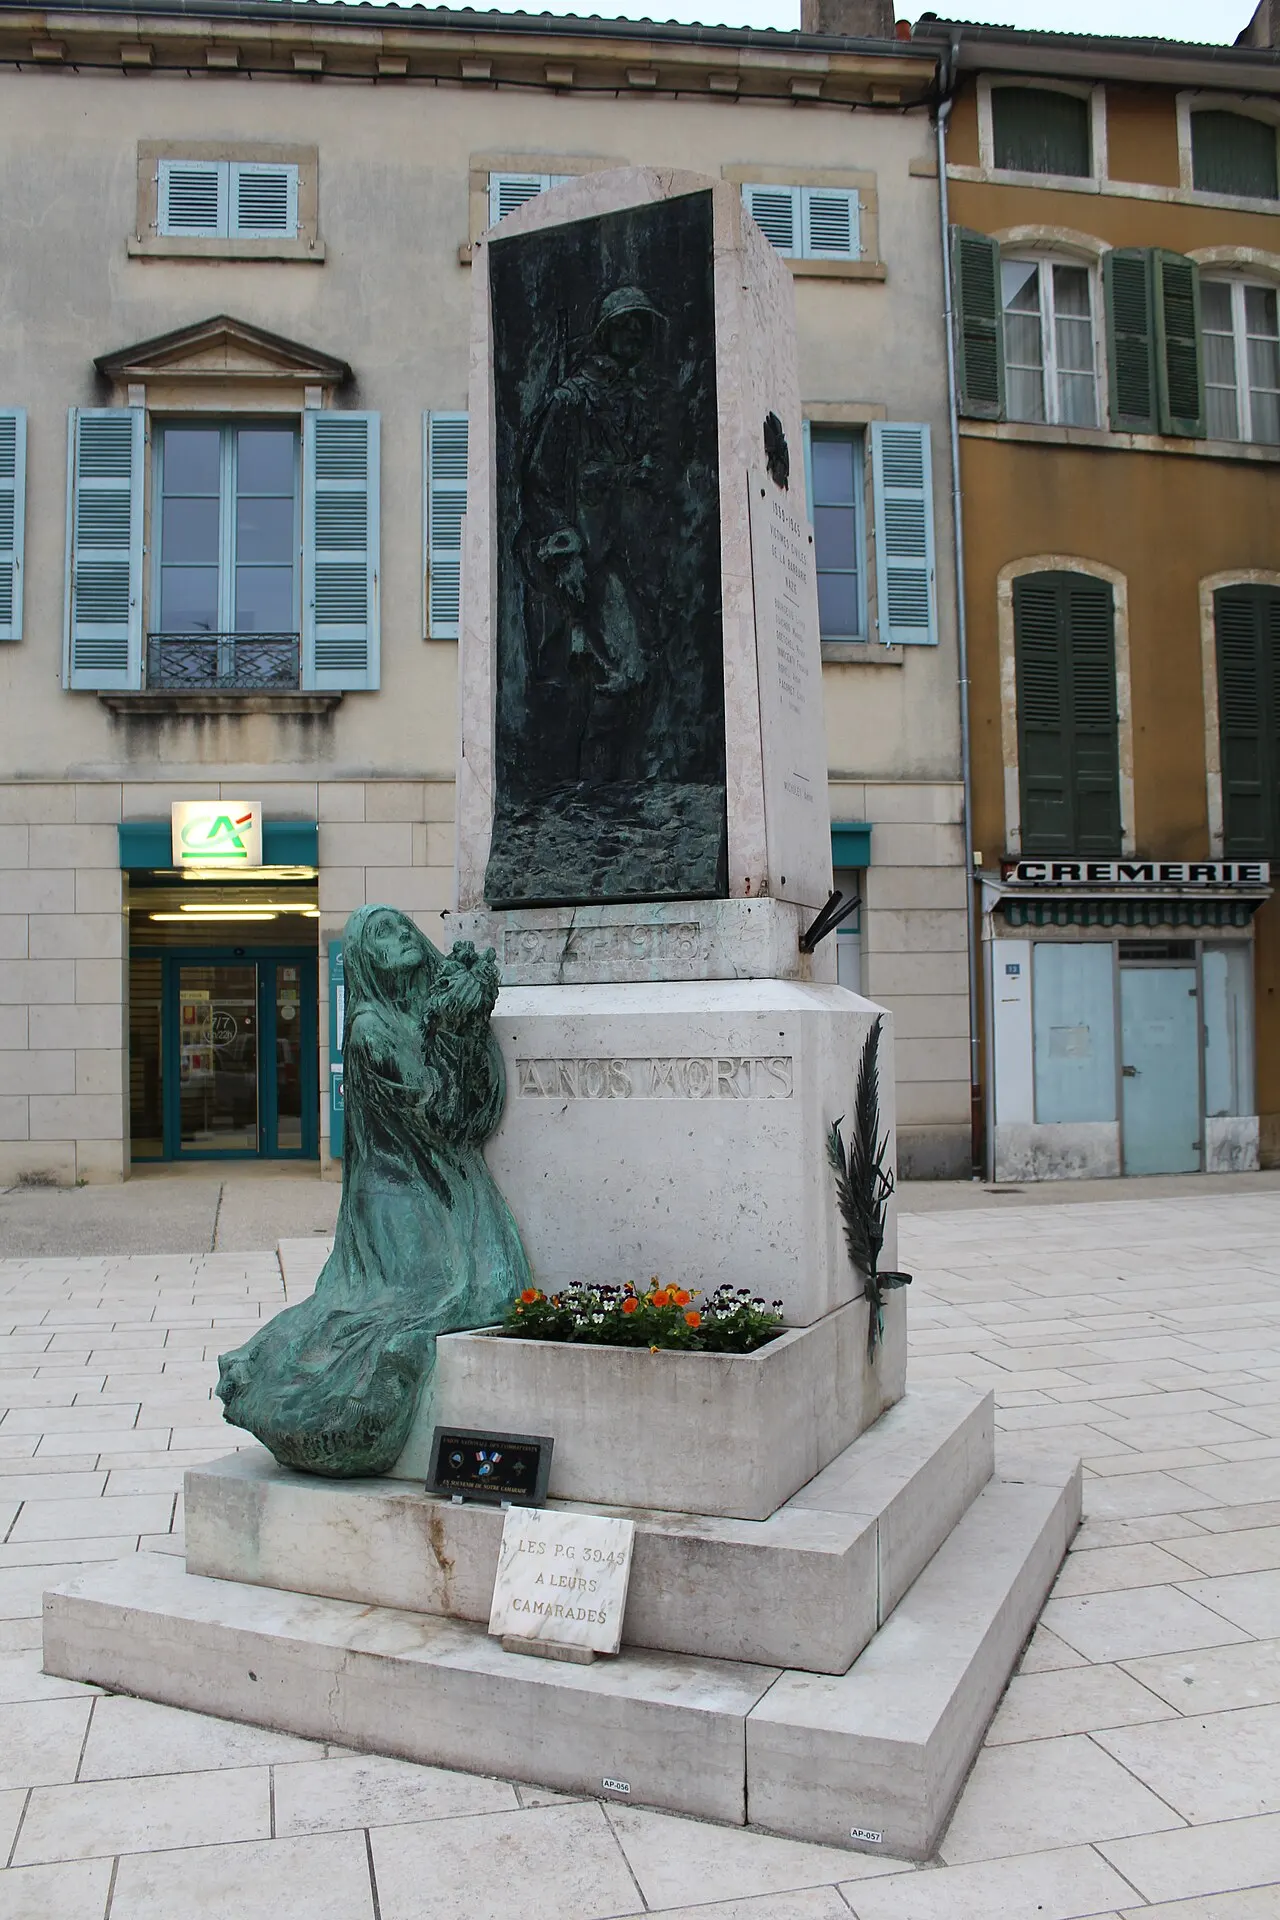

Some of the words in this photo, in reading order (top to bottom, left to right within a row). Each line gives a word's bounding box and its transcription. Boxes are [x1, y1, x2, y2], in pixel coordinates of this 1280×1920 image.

[772, 500, 800, 537] 1939-1945
[772, 544, 778, 559] DE
[1016, 863, 1262, 881] CREMERIE
[518, 1056, 548, 1099] A
[556, 1056, 634, 1099] NOS
[650, 1056, 794, 1099] MORTS
[451, 1480, 474, 1488] SOUVENIR
[518, 1539, 546, 1555] LES
[582, 1547, 626, 1566] 39.45
[535, 1572, 544, 1584] A
[550, 1574, 597, 1593] LEURS
[512, 1598, 607, 1624] CAMARADES
[604, 1780, 629, 1791] AP-056
[852, 1829, 880, 1840] AP-057
